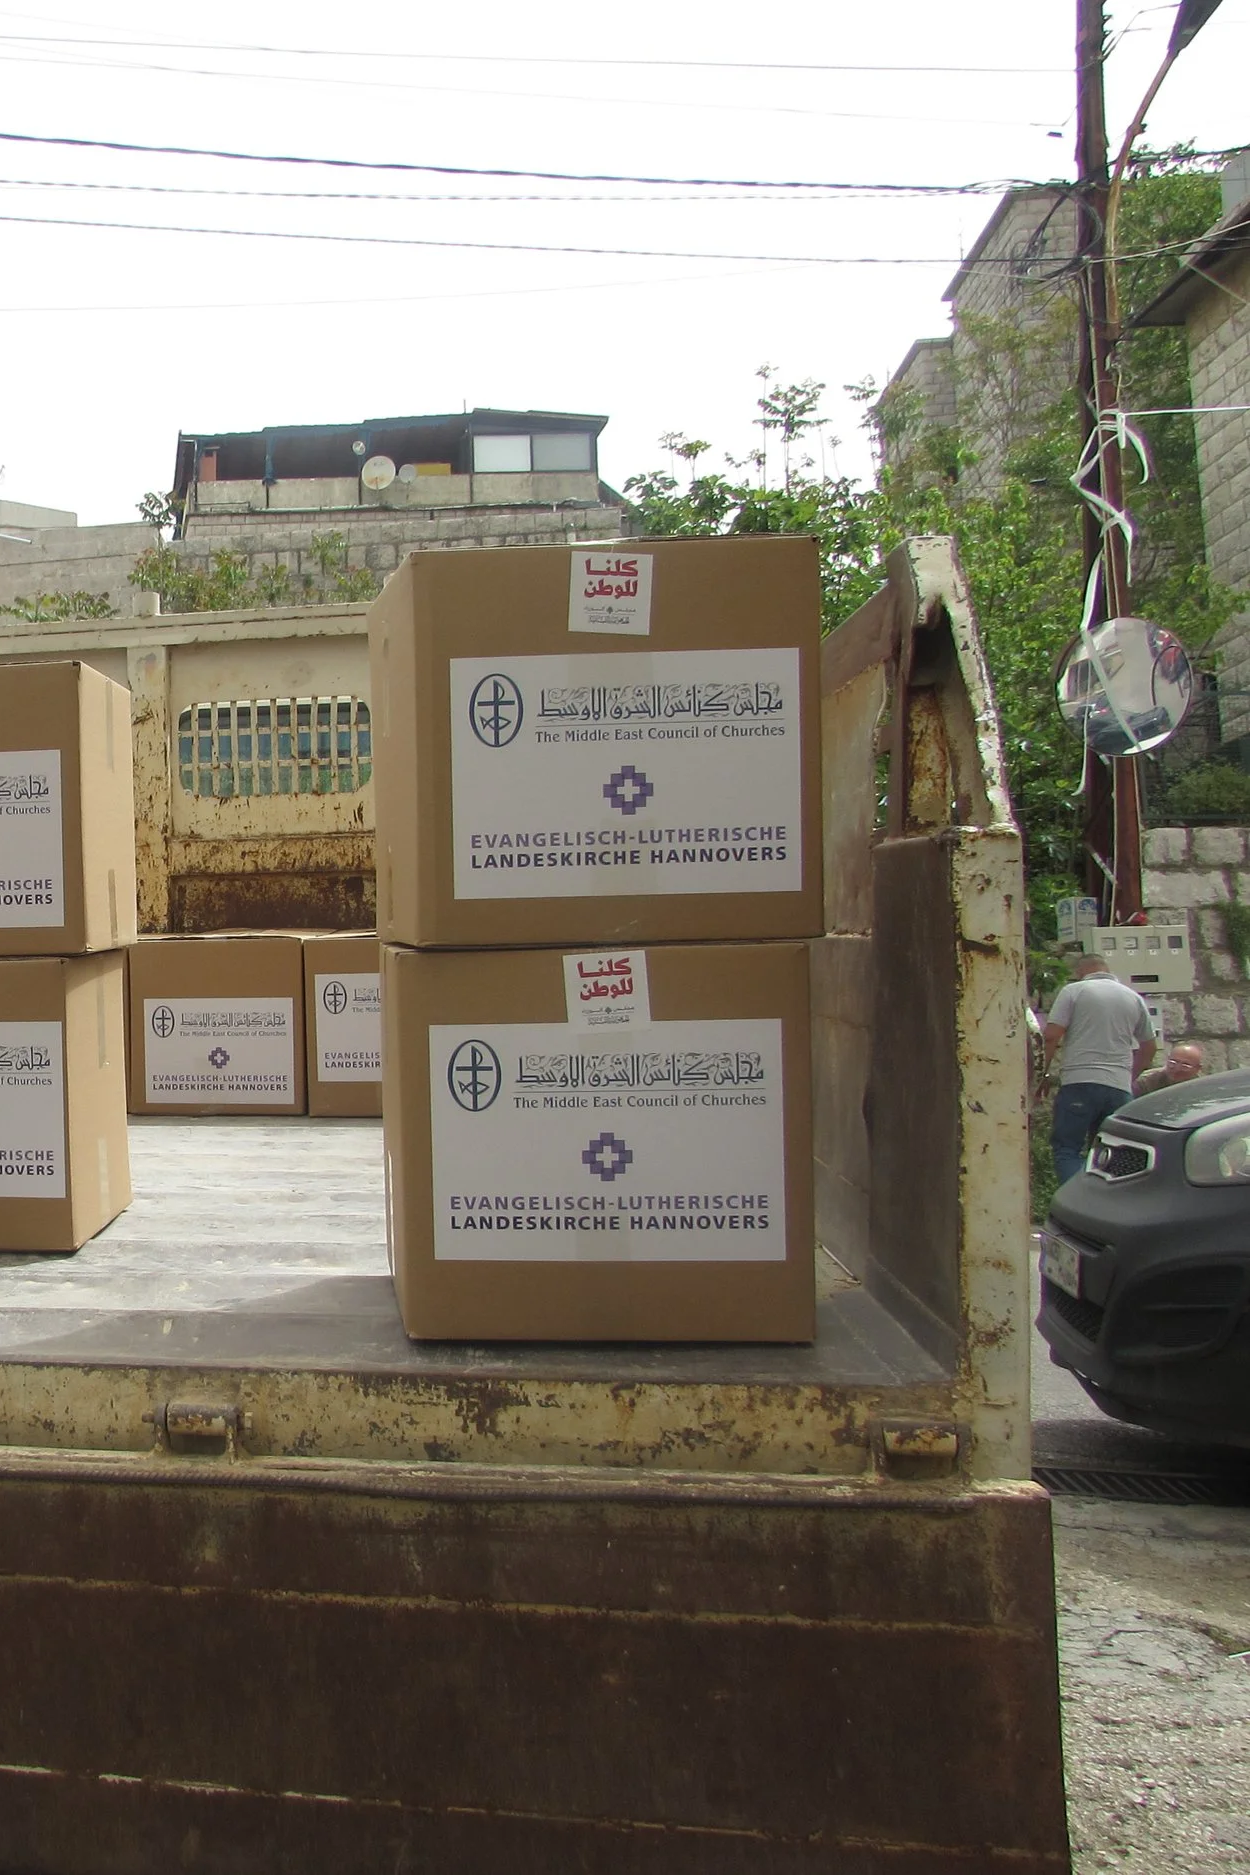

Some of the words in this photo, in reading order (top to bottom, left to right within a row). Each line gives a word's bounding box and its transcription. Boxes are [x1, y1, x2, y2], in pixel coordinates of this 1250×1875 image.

[585, 558, 638, 576] كلنا
[584, 578, 638, 599] للوطن
[535, 731, 559, 743] The
[565, 730, 609, 742] Middle
[614, 728, 643, 740] East
[648, 726, 699, 739] Council
[704, 725, 717, 737] of
[721, 725, 785, 736] Churches
[6, 805, 51, 814] Churches
[471, 826, 786, 848] EVANGELISCH-LUTHERISCHE
[471, 850, 640, 869] LANDESKIRCHE
[650, 847, 786, 864] HANNOVERS
[577, 957, 631, 978] كلنا
[580, 977, 633, 1000] للوطن
[7, 1077, 52, 1085] Churches
[514, 1097, 538, 1108] The
[543, 1097, 588, 1108] Middle
[594, 1096, 622, 1107] East
[627, 1095, 678, 1107] Council
[683, 1095, 696, 1106] of
[702, 1094, 766, 1106] Churches
[451, 1195, 768, 1210] EVANGELISCH-LUTHERISCHE
[451, 1216, 620, 1230] LANDESKIRCHE
[630, 1215, 769, 1230] HANNOVERS
